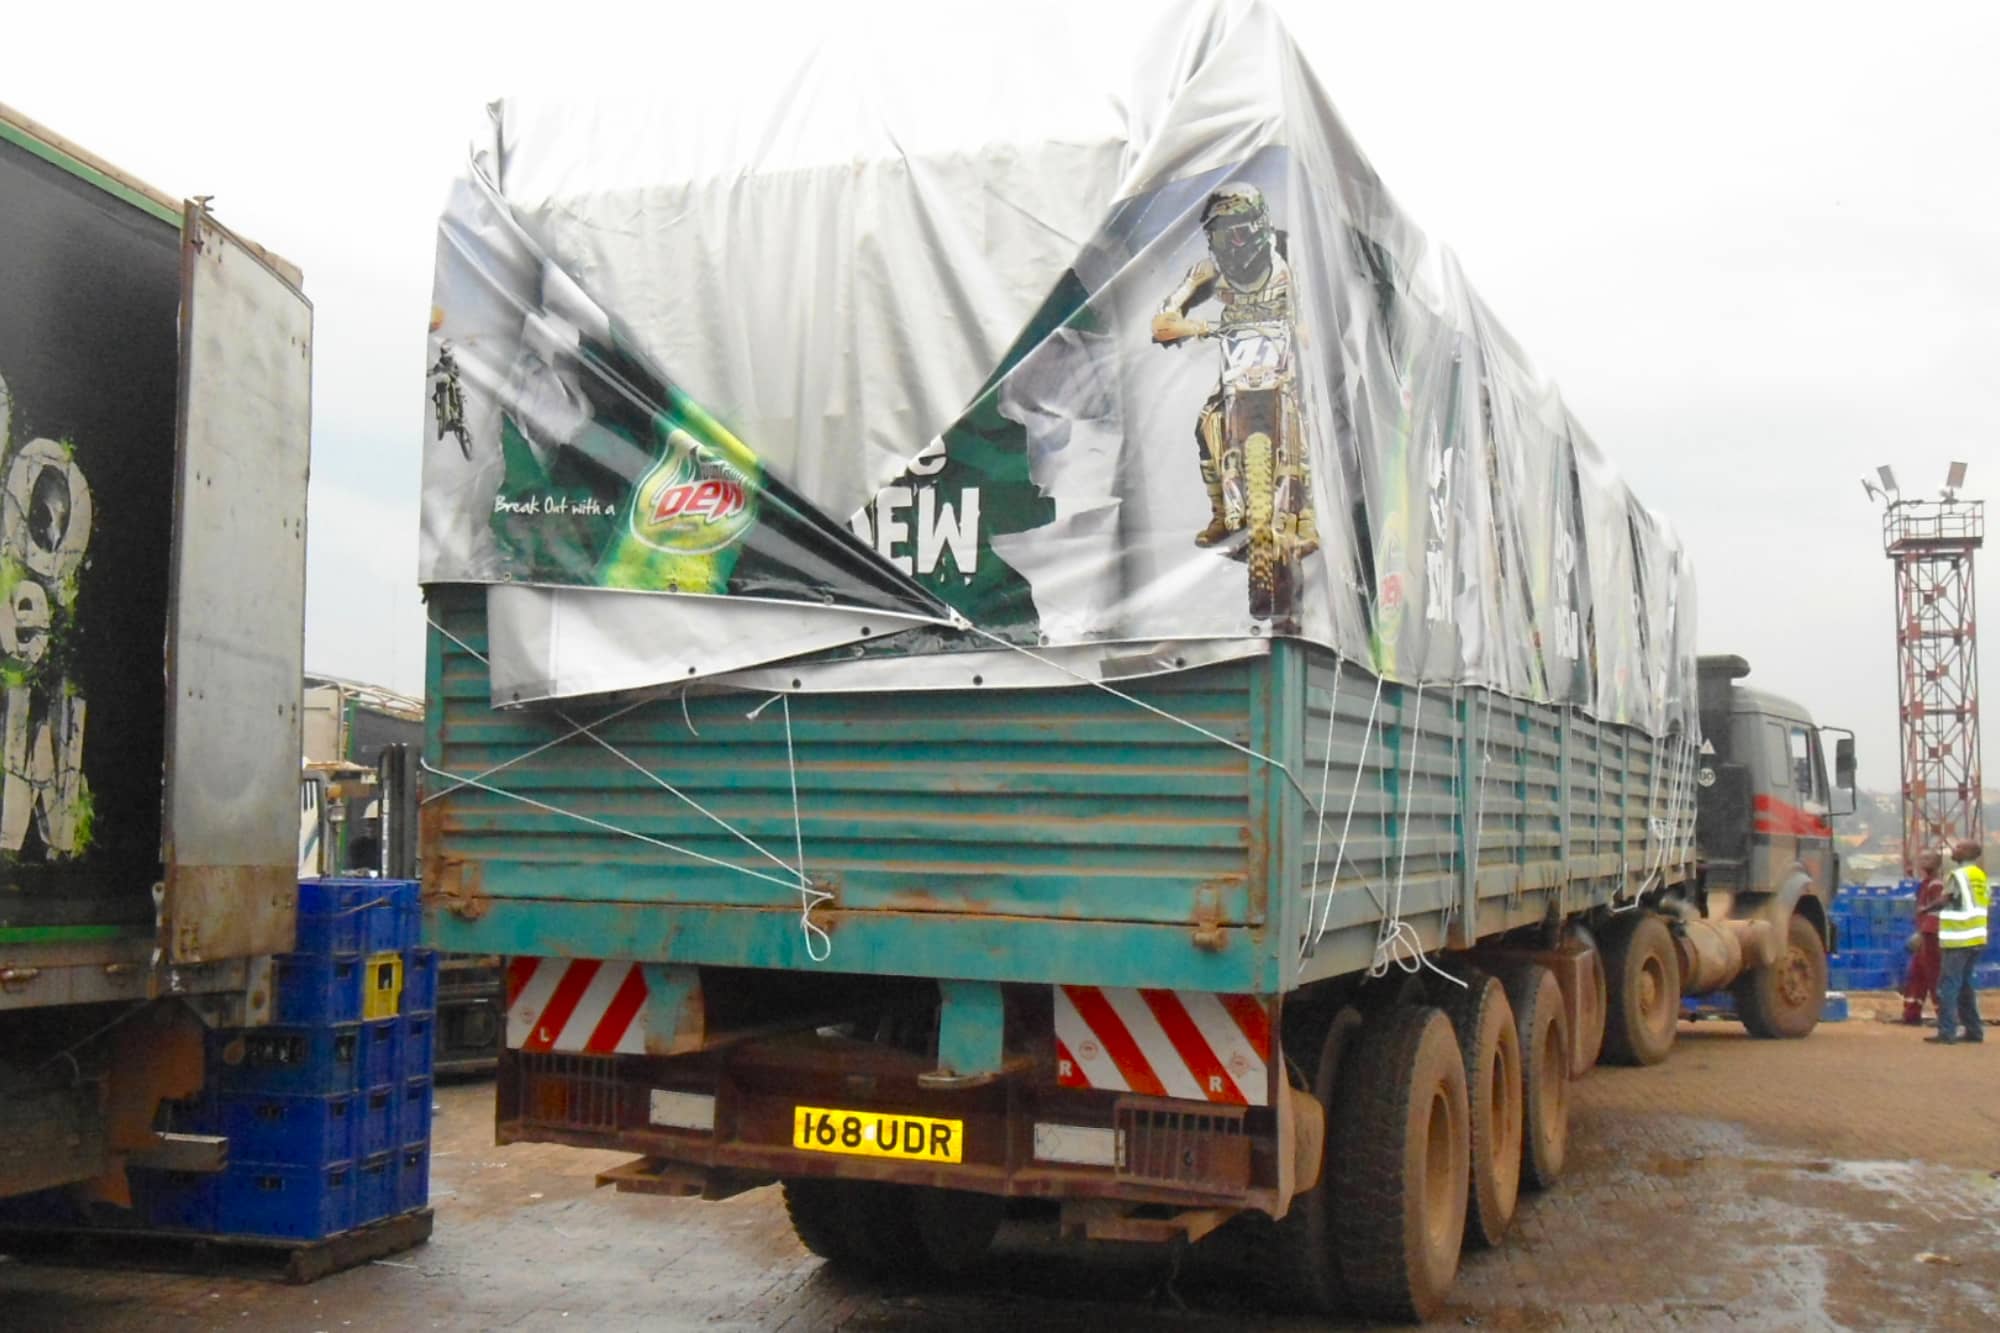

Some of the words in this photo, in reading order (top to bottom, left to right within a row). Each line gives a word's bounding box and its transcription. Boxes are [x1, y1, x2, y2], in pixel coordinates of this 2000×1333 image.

[494, 494, 540, 515] Break
[544, 496, 569, 514] Out
[572, 497, 601, 515] with
[604, 503, 616, 516] a
[539, 1027, 550, 1042] L
[1059, 1060, 1072, 1077] R
[1208, 1075, 1223, 1093] R
[803, 1112, 862, 1148] 168
[876, 1119, 952, 1157] UDR
